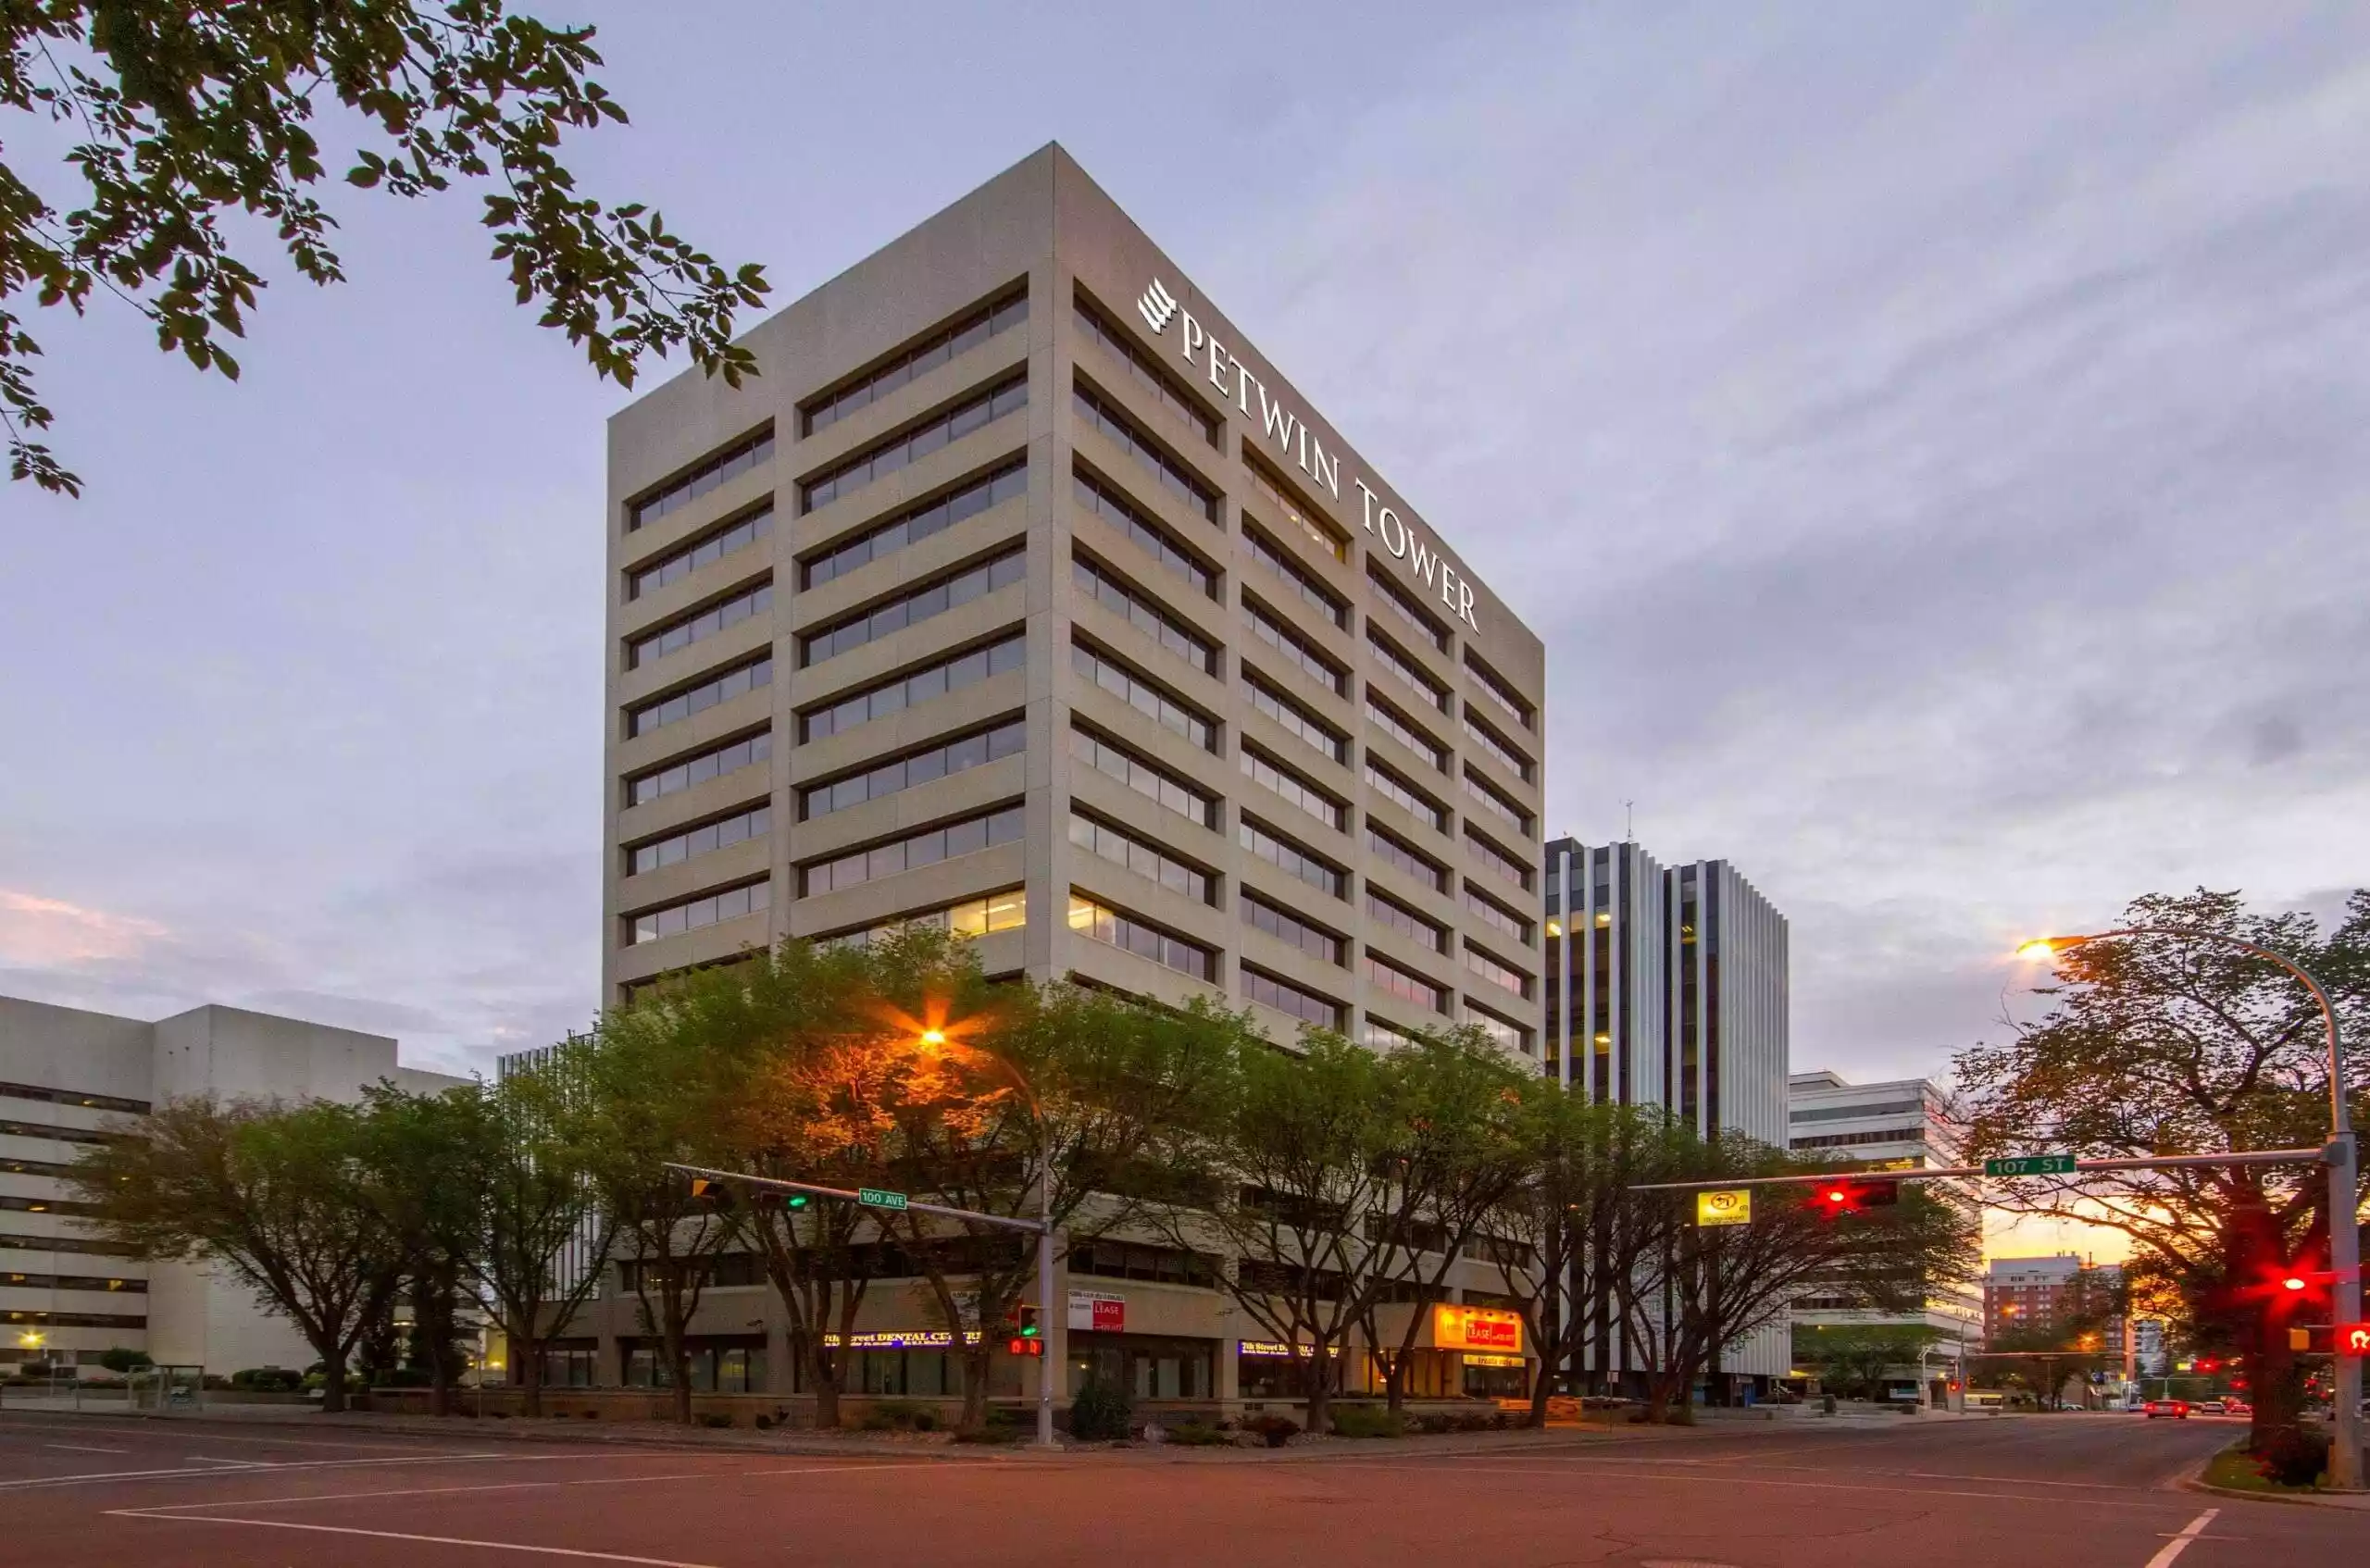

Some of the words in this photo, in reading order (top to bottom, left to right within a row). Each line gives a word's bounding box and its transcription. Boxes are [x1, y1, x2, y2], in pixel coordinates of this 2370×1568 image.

[1179, 305, 1340, 503] PETWIN
[1355, 477, 1481, 636] TOWER
[1995, 1161, 2027, 1174] 107
[2042, 1158, 2065, 1171] ST
[863, 1192, 881, 1203] 100
[886, 1195, 904, 1207] AVE
[1095, 1304, 1118, 1314] LEASE
[877, 1332, 929, 1341] DENTAL
[930, 1332, 982, 1341] CER
[1467, 1326, 1490, 1340] LEASE
